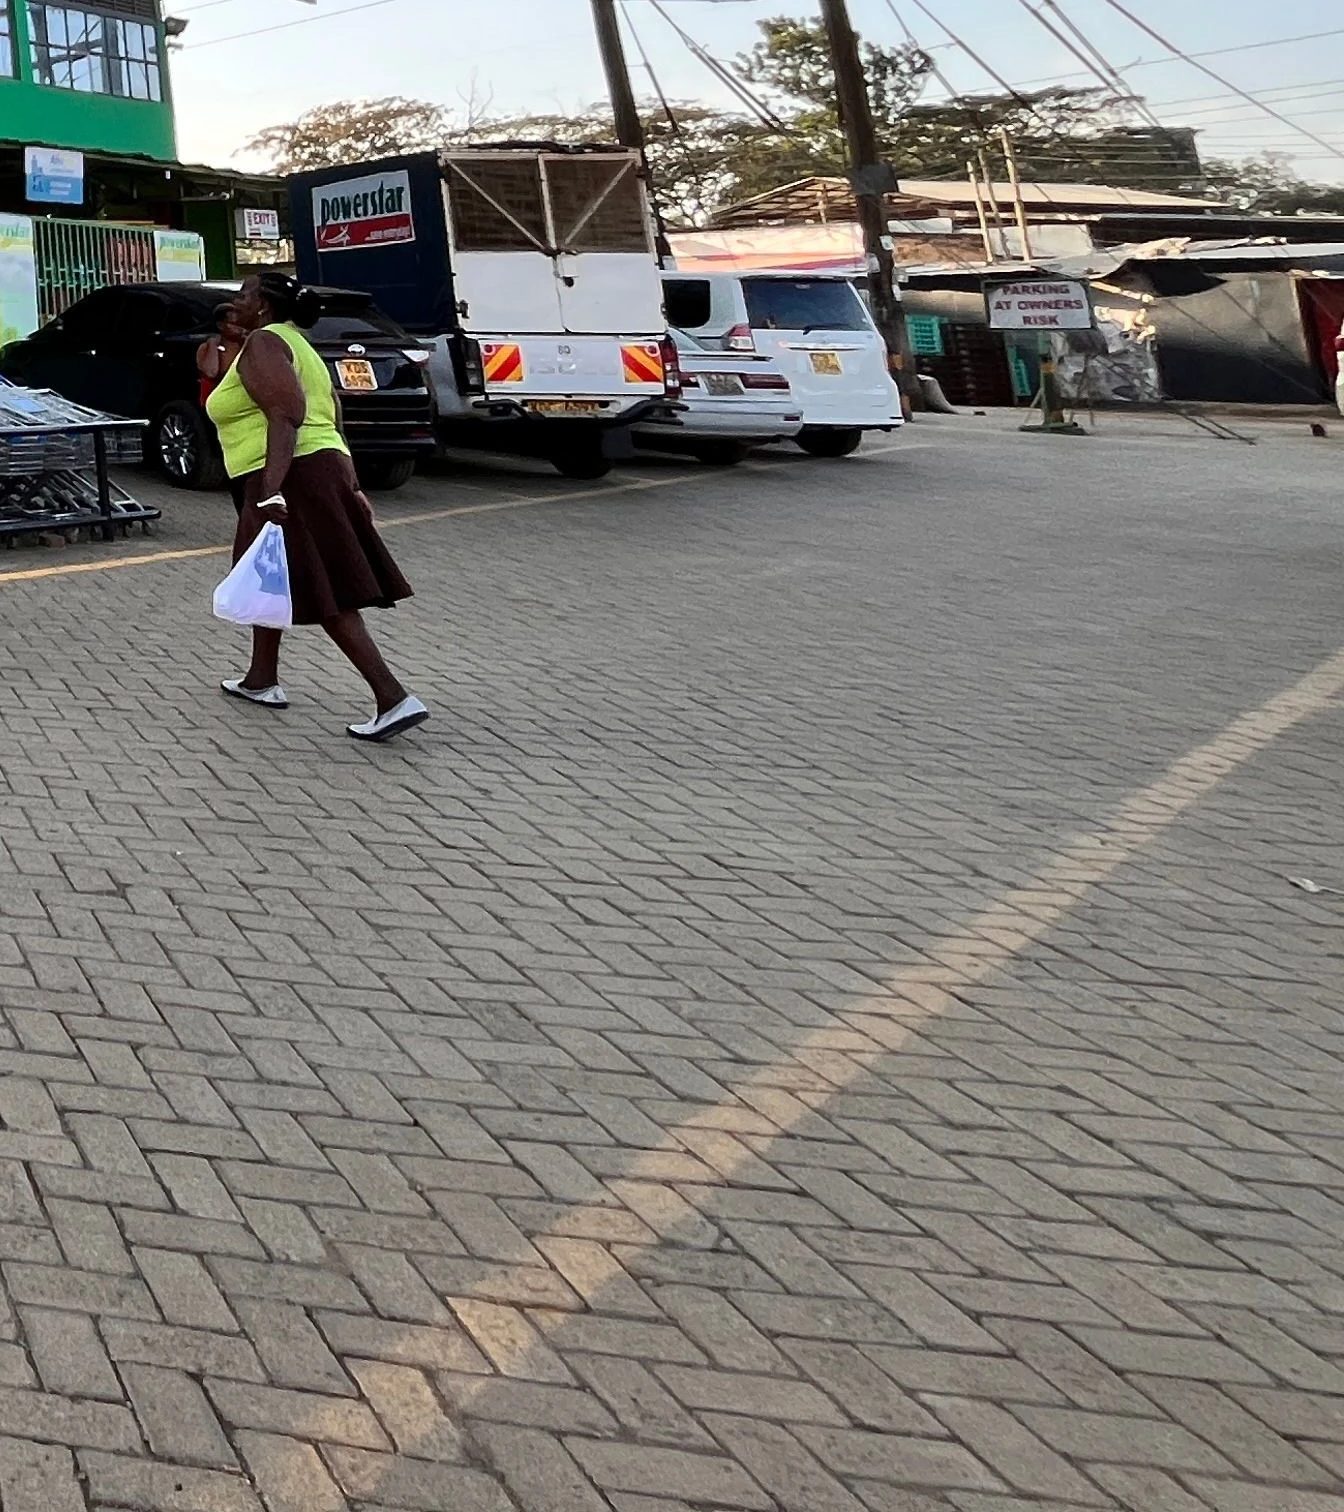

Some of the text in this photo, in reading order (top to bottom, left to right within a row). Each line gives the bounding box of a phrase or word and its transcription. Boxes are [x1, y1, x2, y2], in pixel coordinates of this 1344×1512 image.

[320, 180, 405, 229] powerstar
[1001, 284, 1070, 295] PARKING
[994, 299, 1084, 310] AT OWNERS
[1022, 315, 1060, 326] RISK
